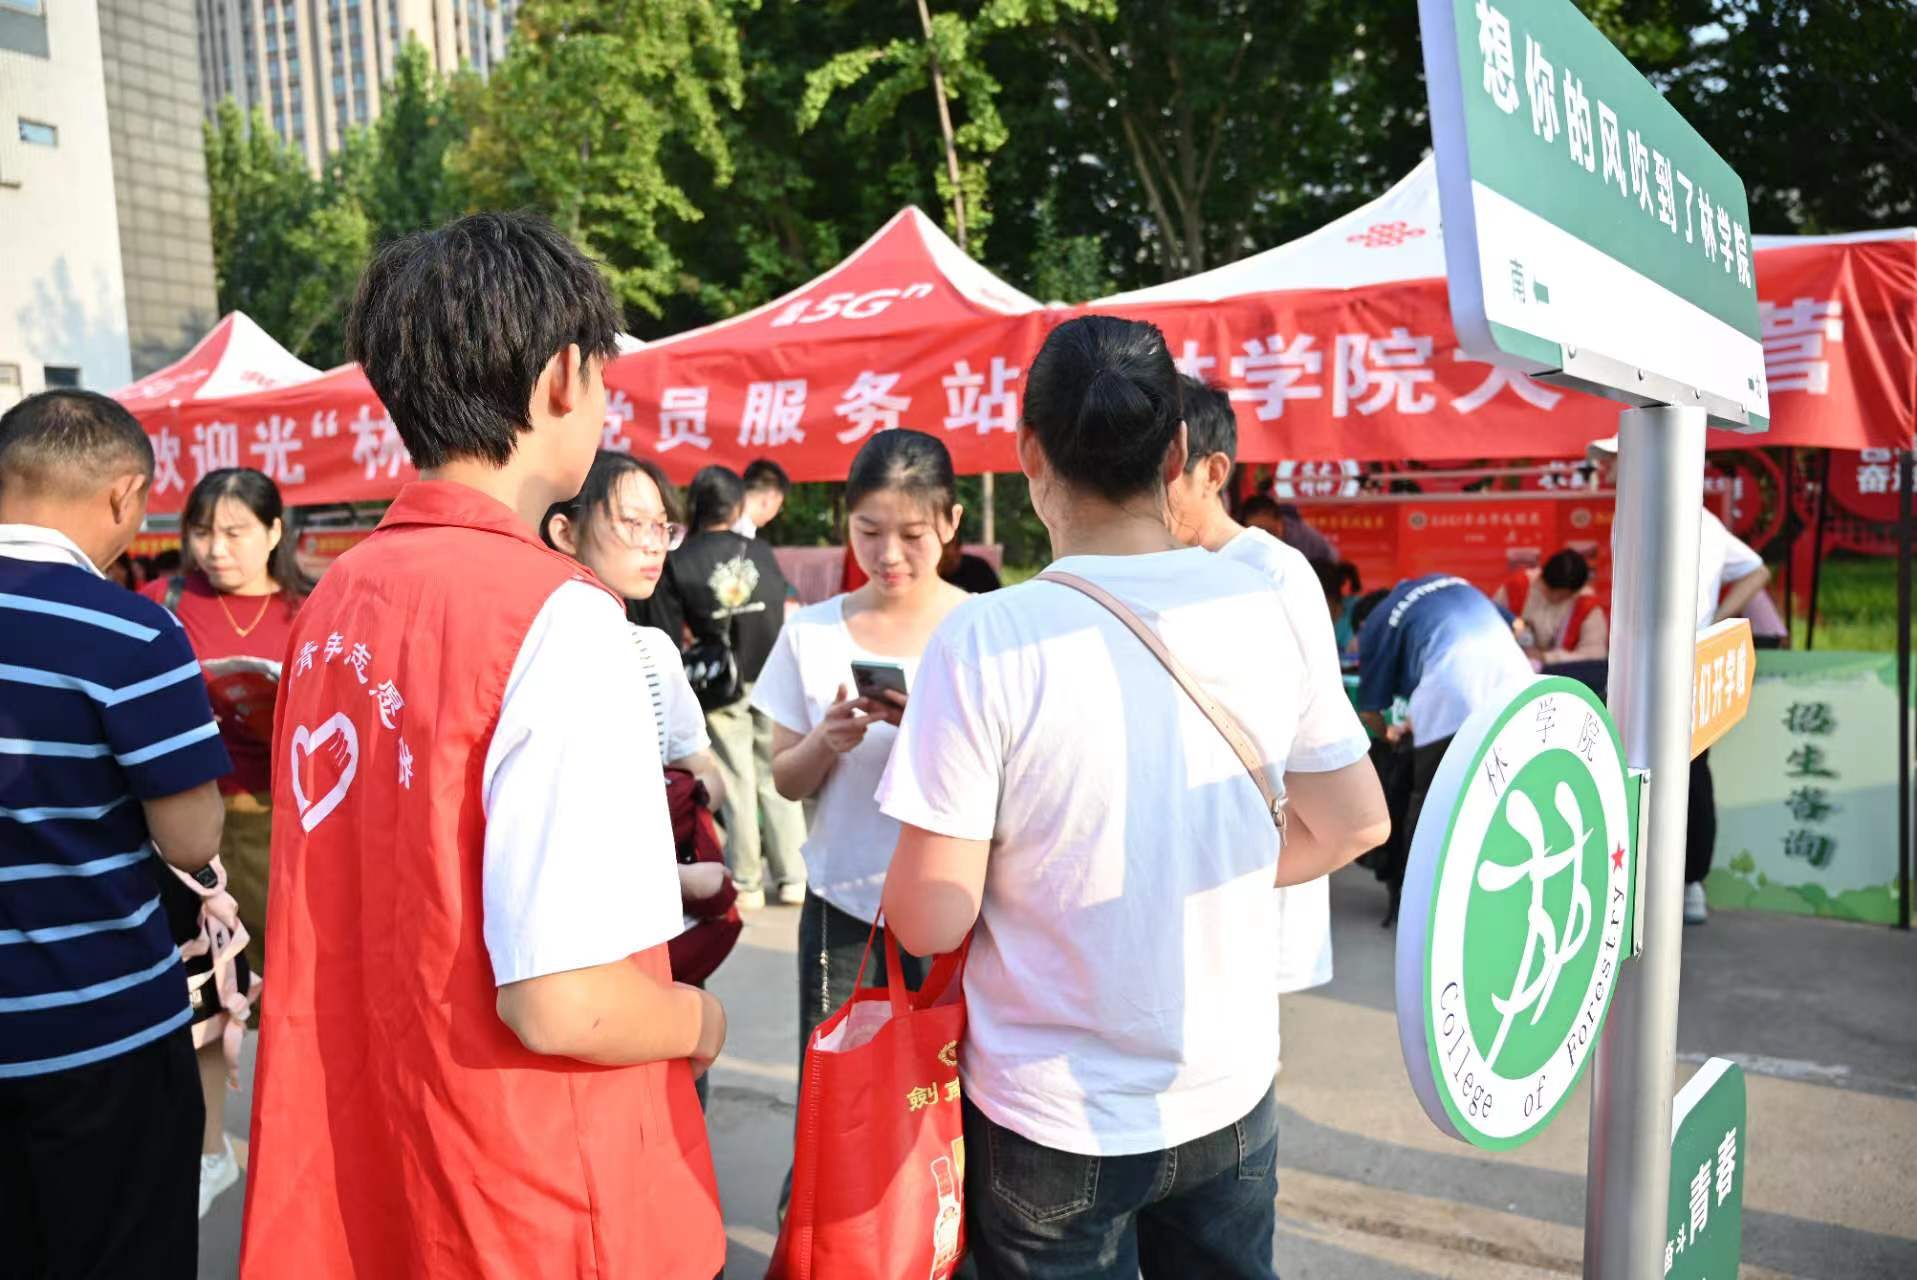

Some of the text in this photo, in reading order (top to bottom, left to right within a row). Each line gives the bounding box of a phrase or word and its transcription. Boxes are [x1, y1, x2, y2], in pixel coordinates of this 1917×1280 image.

[1475, 0, 1751, 288] 想你的风吹到了林学院
[1484, 697, 1601, 797] 林学院
[1782, 702, 1840, 869] 招生咨询
[1440, 887, 1624, 1118] College of Forestry
